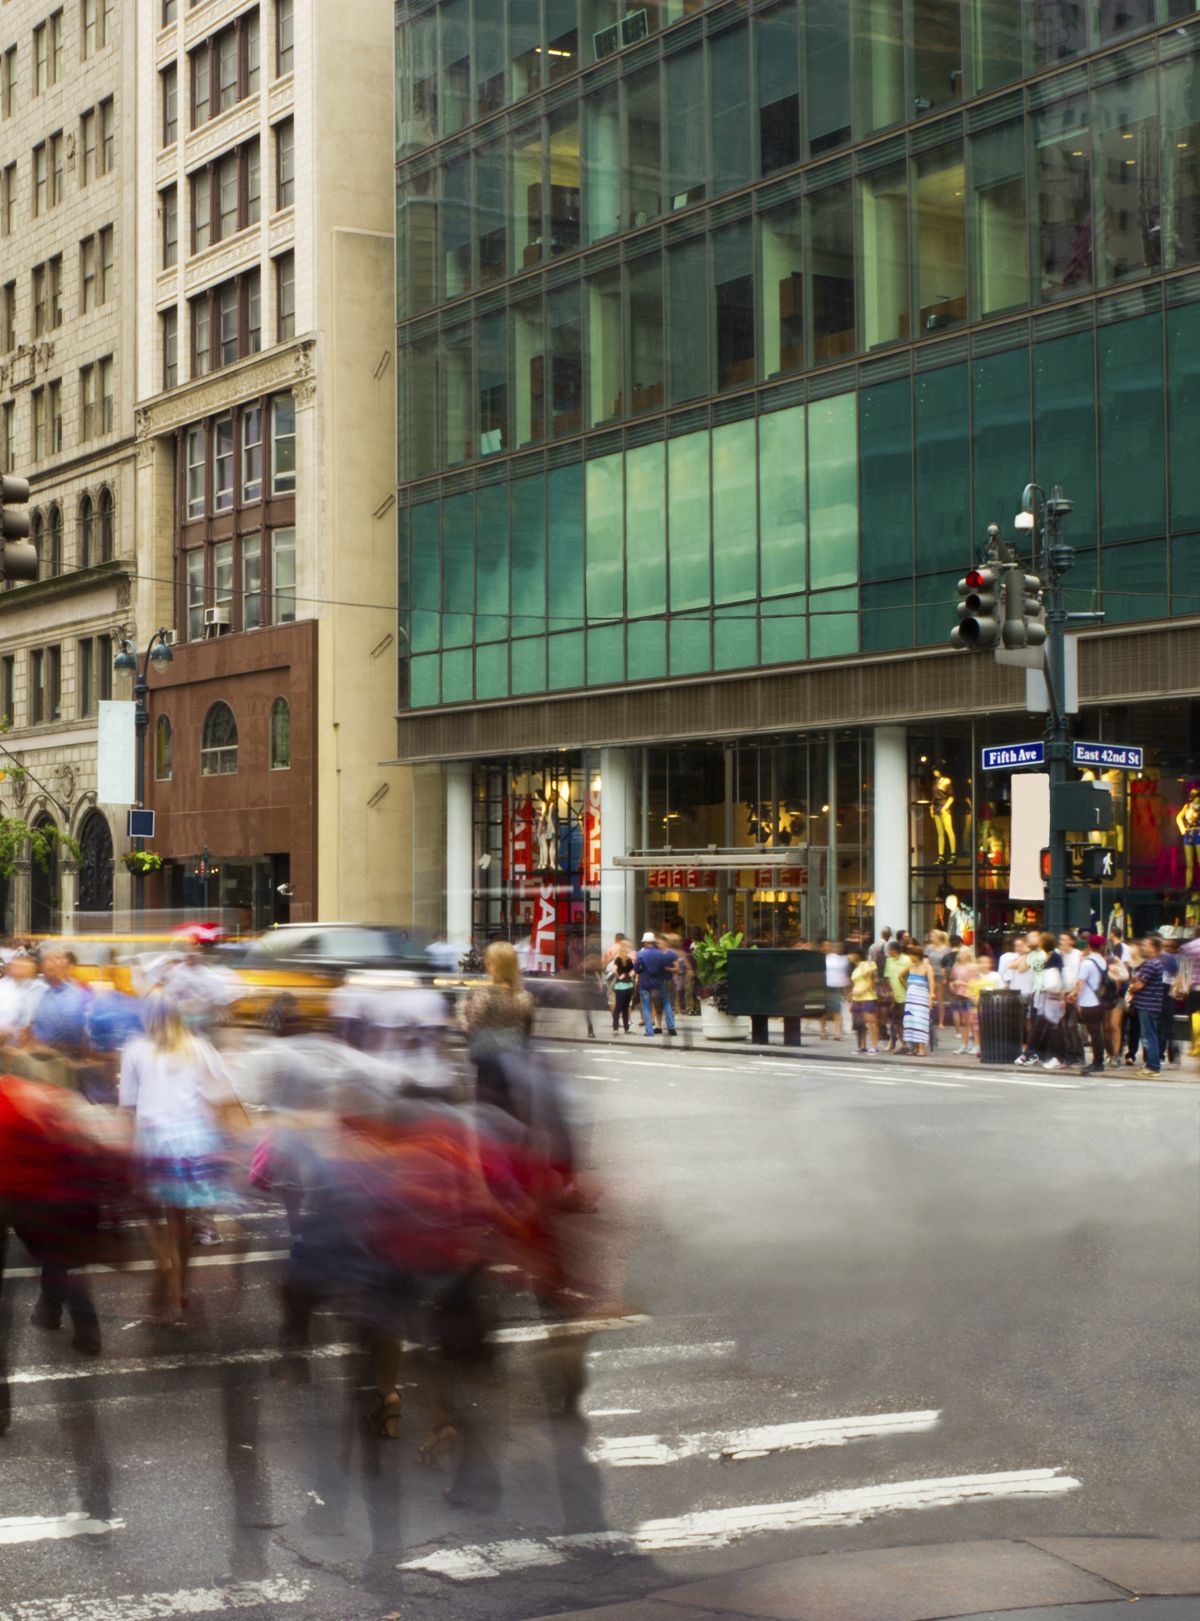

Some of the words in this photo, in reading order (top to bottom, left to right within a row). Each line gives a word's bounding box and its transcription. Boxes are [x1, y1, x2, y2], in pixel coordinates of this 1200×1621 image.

[989, 749, 1017, 765] Fifth
[1018, 749, 1037, 762] Ave
[1076, 747, 1100, 761] East
[1101, 749, 1126, 764] 42nd
[1128, 752, 1140, 765] St
[533, 882, 556, 973] SALE
